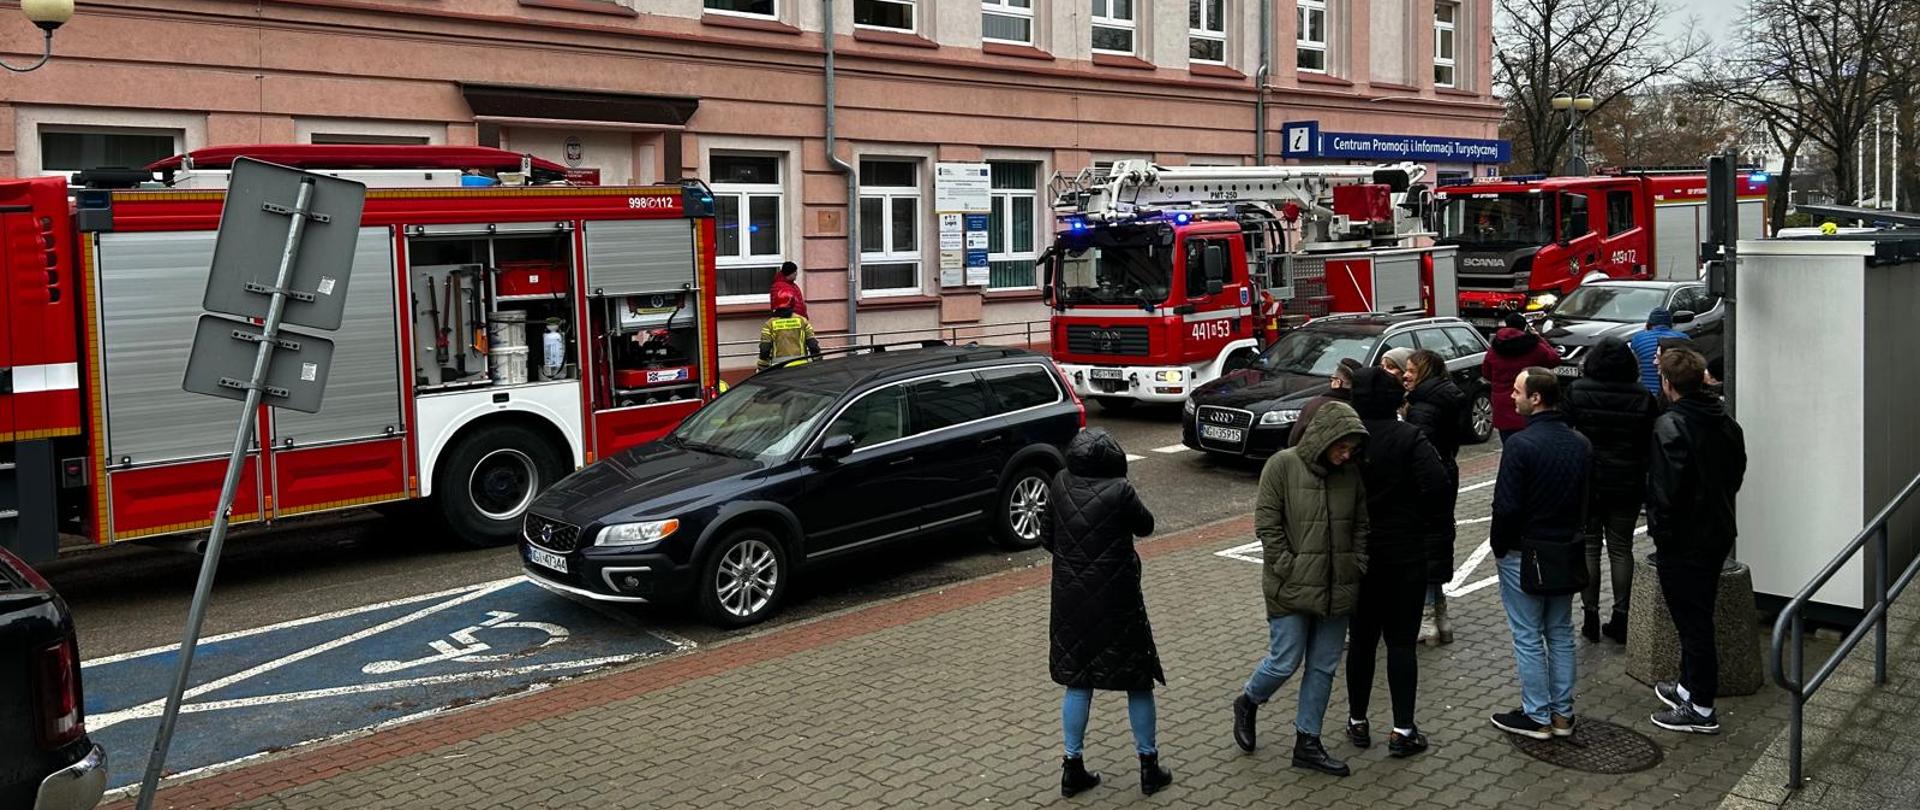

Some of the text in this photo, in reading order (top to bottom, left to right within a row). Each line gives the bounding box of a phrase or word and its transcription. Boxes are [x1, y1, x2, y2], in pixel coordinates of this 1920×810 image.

[1333, 137, 1498, 159] Centrum Promocji i Informacji Turystycznej
[628, 197, 673, 209] 998 112
[1463, 257, 1506, 268] SCANIA
[1091, 331, 1121, 341] MAN
[1218, 428, 1241, 441] 35915
